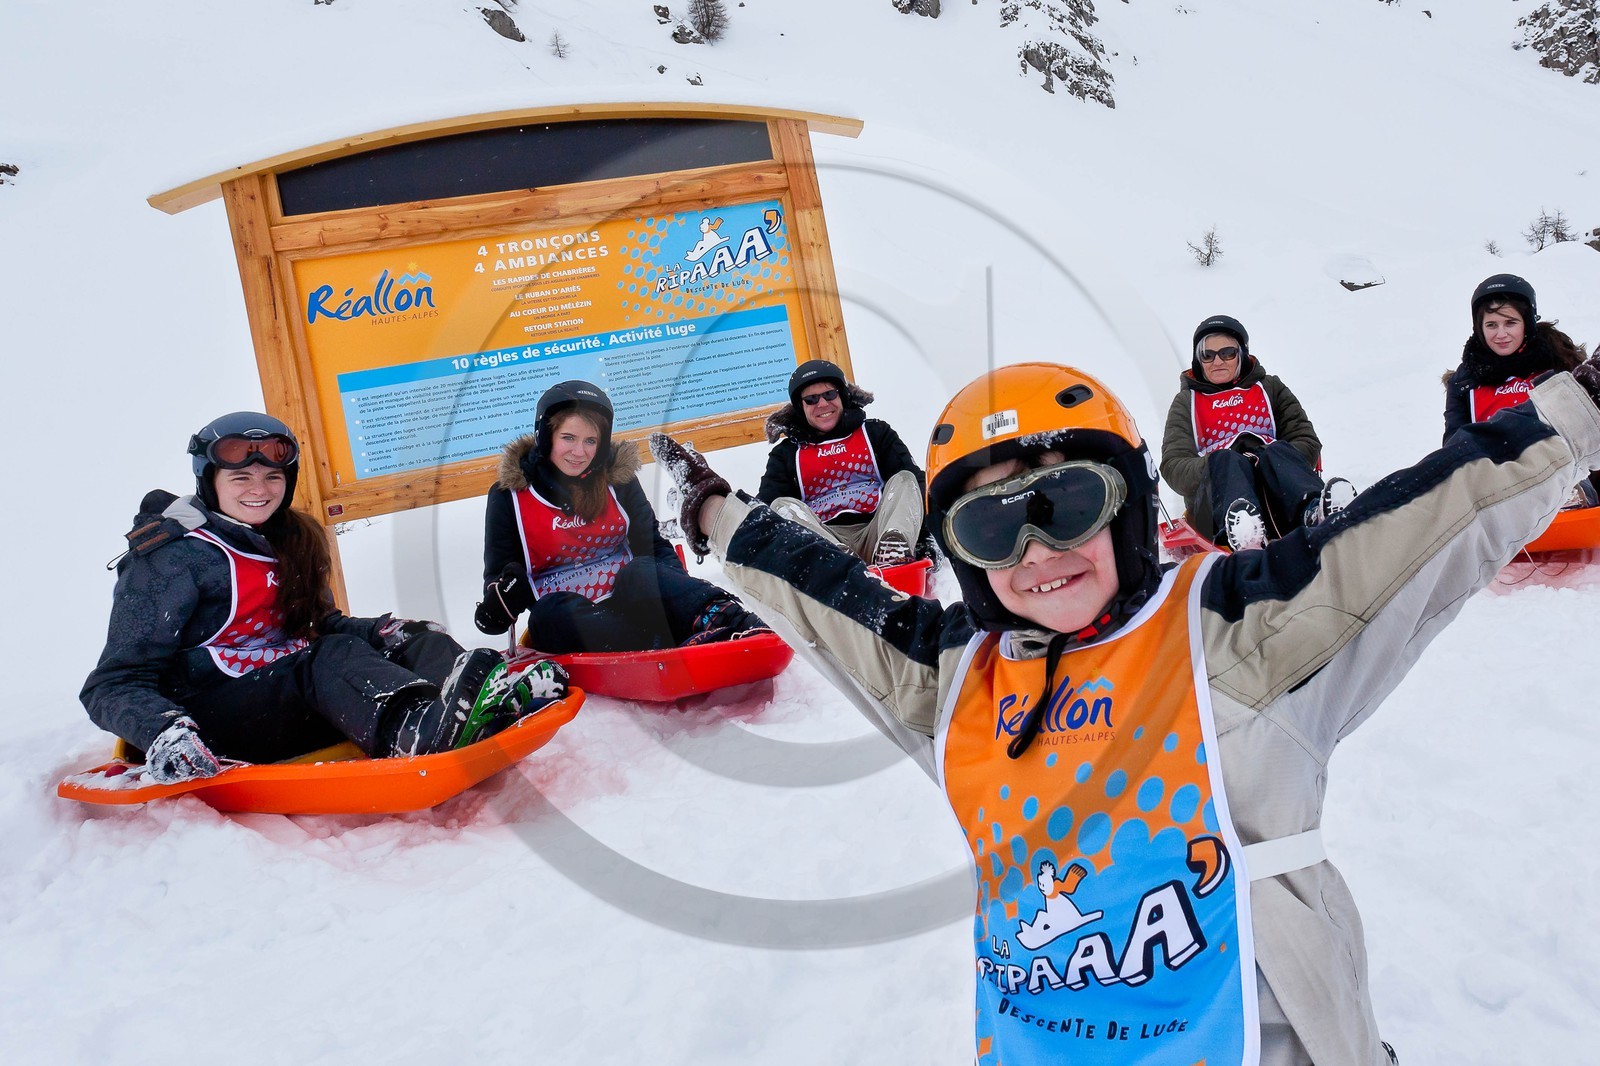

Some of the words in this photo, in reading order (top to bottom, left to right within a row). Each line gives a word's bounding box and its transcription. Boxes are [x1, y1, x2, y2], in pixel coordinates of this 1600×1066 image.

[475, 245, 489, 257] 4
[496, 230, 600, 254] TRONÇONS
[472, 262, 486, 275] 4
[494, 246, 609, 272] AMBIANCES
[666, 263, 682, 272] LA
[492, 277, 506, 286] LES
[506, 273, 539, 284] RAPIDES
[539, 271, 551, 279] DE
[552, 266, 596, 278] CHABRIÈRES
[307, 269, 436, 324] Réallon
[514, 292, 524, 301] LE
[524, 288, 551, 299] RUBAN
[686, 284, 718, 294] DESCENTE
[370, 310, 440, 326] HAUTES-ALPES
[508, 310, 521, 318] AU
[521, 306, 547, 316] COEUR
[547, 304, 560, 312] DU
[559, 298, 592, 310] MÉLÉZIN
[522, 322, 553, 332] RETOUR
[552, 317, 584, 328] STATION
[452, 357, 470, 370] 10
[472, 350, 518, 368] règles
[520, 345, 541, 359] de
[544, 336, 605, 353] sécurité.
[608, 328, 662, 344] Activité
[665, 322, 696, 338] luge
[1037, 731, 1116, 748] HAUTES-ALPES
[992, 935, 1010, 960] LA
[998, 998, 1096, 1040] DESCENTE
[1107, 1020, 1128, 1041] DE
[1140, 1019, 1189, 1040] LUGE
